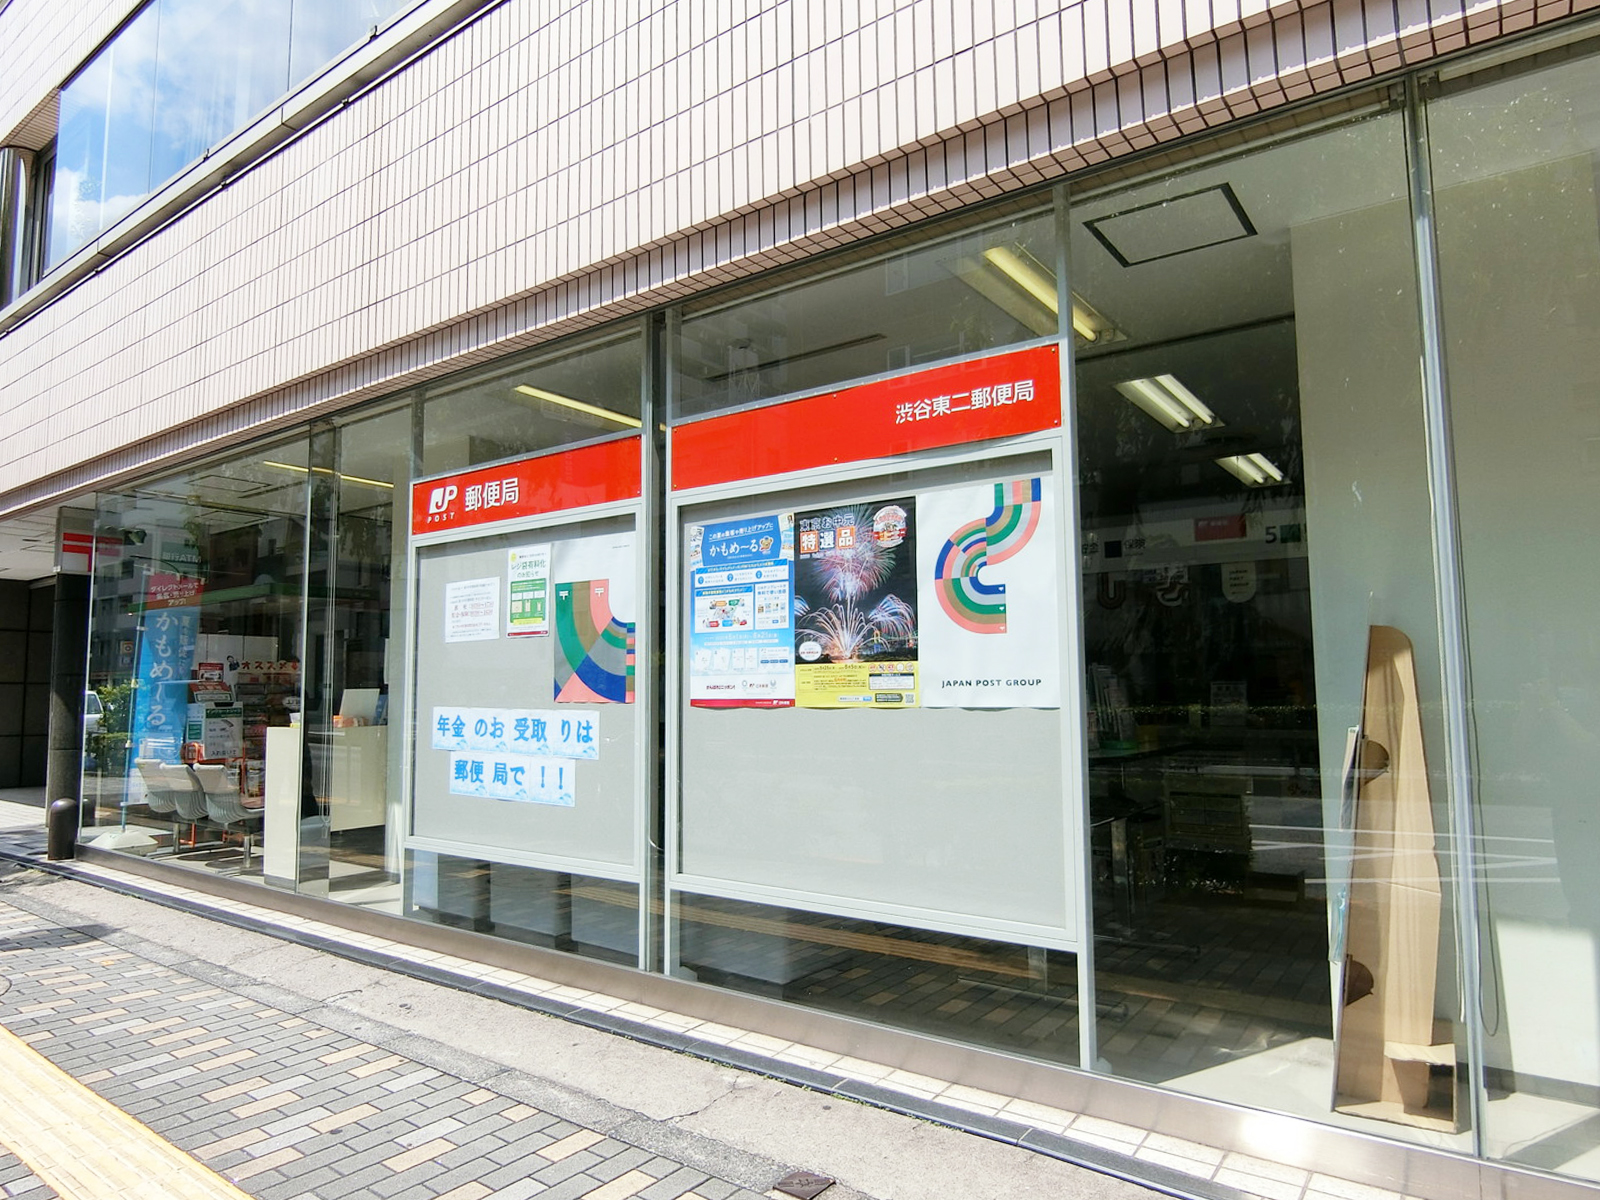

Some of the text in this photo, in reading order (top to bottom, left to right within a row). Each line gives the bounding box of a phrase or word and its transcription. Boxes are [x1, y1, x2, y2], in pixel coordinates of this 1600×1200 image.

[895, 379, 1034, 424] 渋谷東二郵便局
[465, 477, 519, 512] 郵便局
[427, 511, 456, 524] POST
[799, 513, 855, 532] 東京お中元
[801, 528, 854, 551] 特選品
[1124, 537, 1146, 549] 保険
[1265, 525, 1277, 544] 5
[241, 661, 287, 670] オススメ
[941, 678, 1042, 689] JAPAN POST GROUP
[437, 714, 593, 743] 年金のお受取りは
